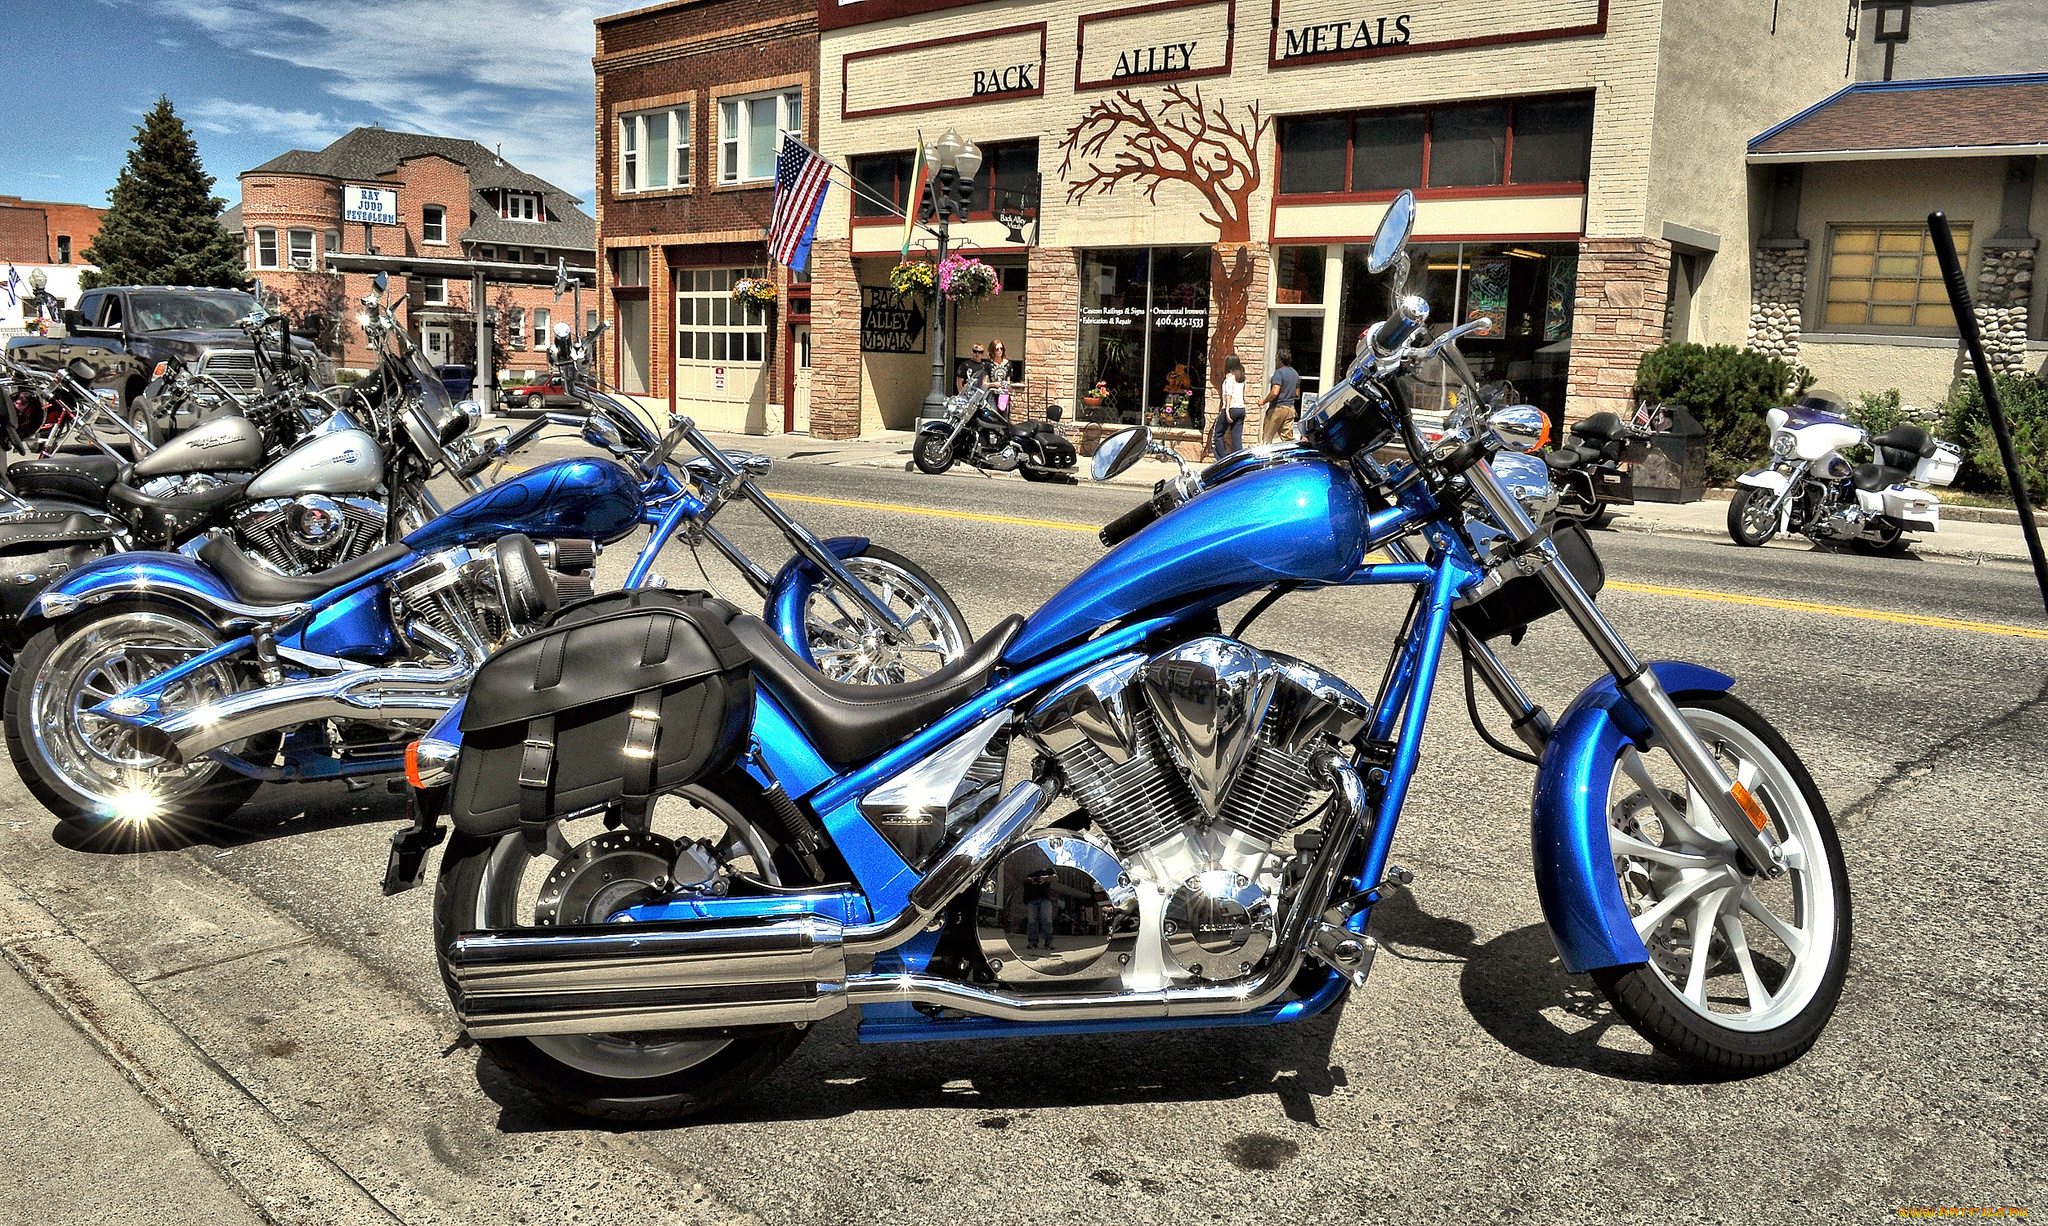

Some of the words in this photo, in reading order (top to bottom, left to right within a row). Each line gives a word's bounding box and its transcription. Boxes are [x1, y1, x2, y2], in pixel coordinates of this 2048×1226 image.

[972, 63, 1034, 97] BACK
[1111, 41, 1198, 80] ALLEY
[1283, 14, 1411, 59] METALS
[361, 190, 380, 201] RAY
[357, 200, 383, 212] JUDD
[346, 209, 395, 224] PETROLEUM
[1000, 213, 1012, 222] Back
[870, 288, 906, 311] BACK
[1082, 306, 1103, 315] Custom
[1103, 306, 1124, 316] Railings
[1130, 306, 1146, 316] Signs
[1152, 306, 1184, 315] Ornamental
[864, 310, 912, 331] ALLEY
[1082, 316, 1109, 325] Fabrication
[1115, 316, 1132, 326] Repair
[1155, 314, 1204, 328] 406.425.1533
[861, 330, 912, 350] METALS
